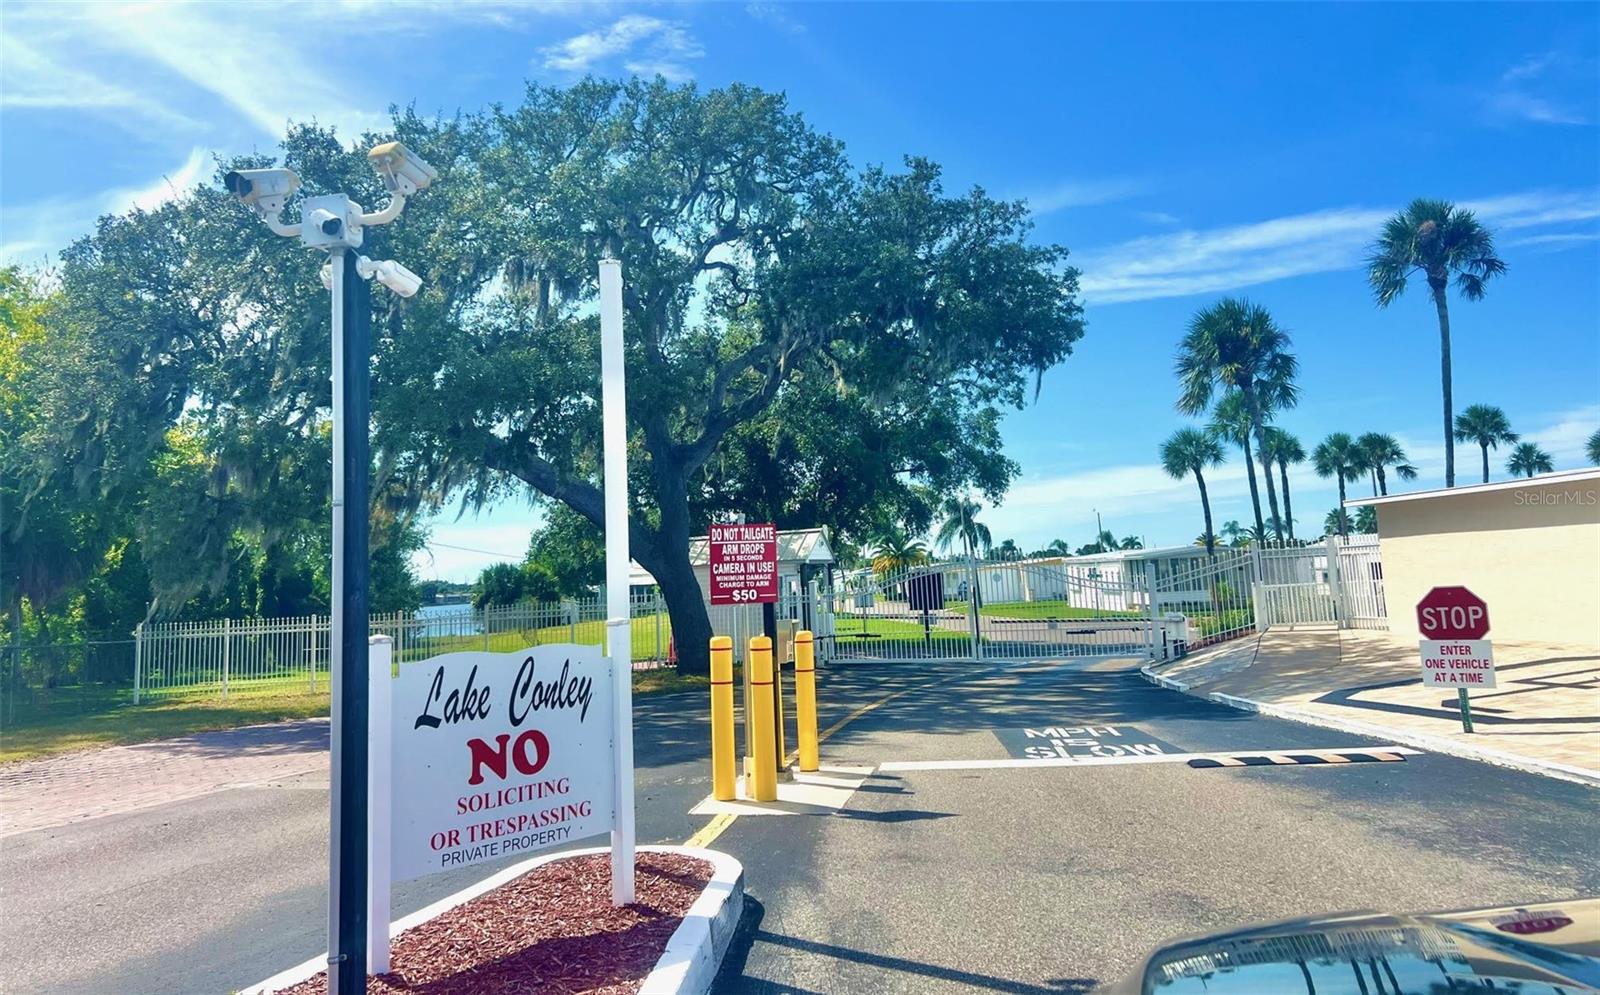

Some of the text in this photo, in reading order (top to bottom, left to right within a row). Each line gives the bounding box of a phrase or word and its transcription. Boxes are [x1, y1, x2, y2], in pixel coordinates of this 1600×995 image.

[711, 527, 774, 541] DO NOT TAILGATE
[722, 543, 765, 555] ARM DROPS
[713, 561, 775, 574] CAMERA IN USE!
[732, 589, 757, 601] $50
[1422, 606, 1483, 630] STOP
[1440, 645, 1472, 655] ENTER
[1425, 659, 1490, 669] ONE VEHICLE
[1434, 672, 1484, 683] AT A TIME
[414, 656, 593, 730] Lake Conley
[1023, 726, 1122, 738] MPH
[466, 729, 550, 785] NO
[1025, 743, 1165, 759] SLOW
[457, 777, 570, 815] SOLICITING
[430, 800, 592, 851] OR TRESPASSING
[441, 825, 572, 867] PRIVATE PROPERTY
